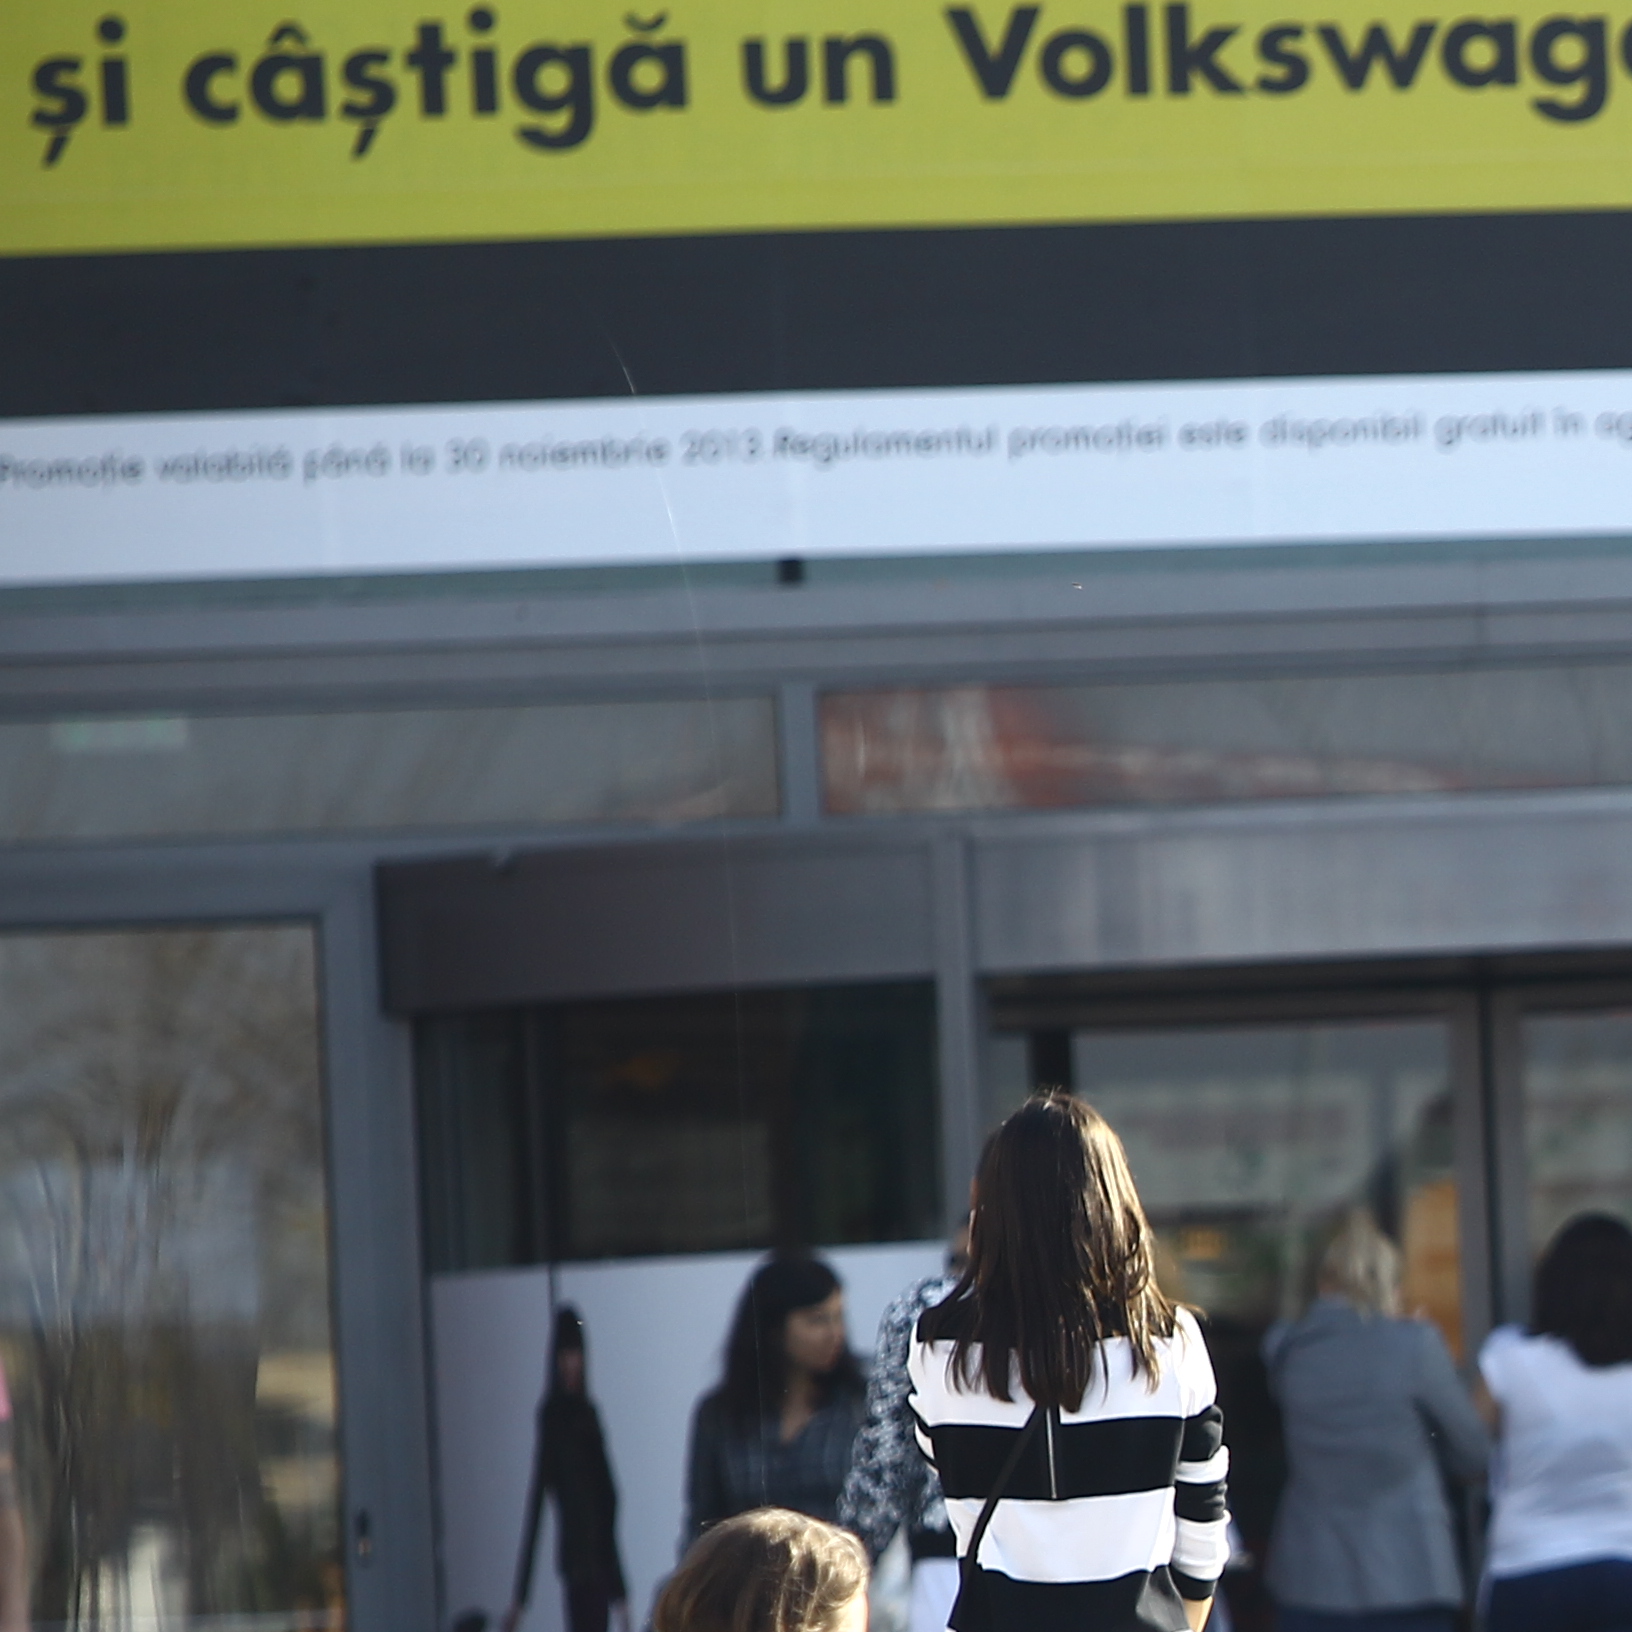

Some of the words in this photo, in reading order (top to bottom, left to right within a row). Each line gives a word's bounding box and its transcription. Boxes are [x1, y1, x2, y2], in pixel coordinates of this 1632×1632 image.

[29, 14, 132, 168] și
[182, 5, 692, 160] câștigă
[741, 32, 898, 109] un
[501, 430, 672, 472] noiembrie
[773, 424, 997, 472] Regulamentul
[1178, 415, 1249, 453] este
[1257, 408, 1428, 457] disponibil
[1433, 404, 1545, 454] gratuit
